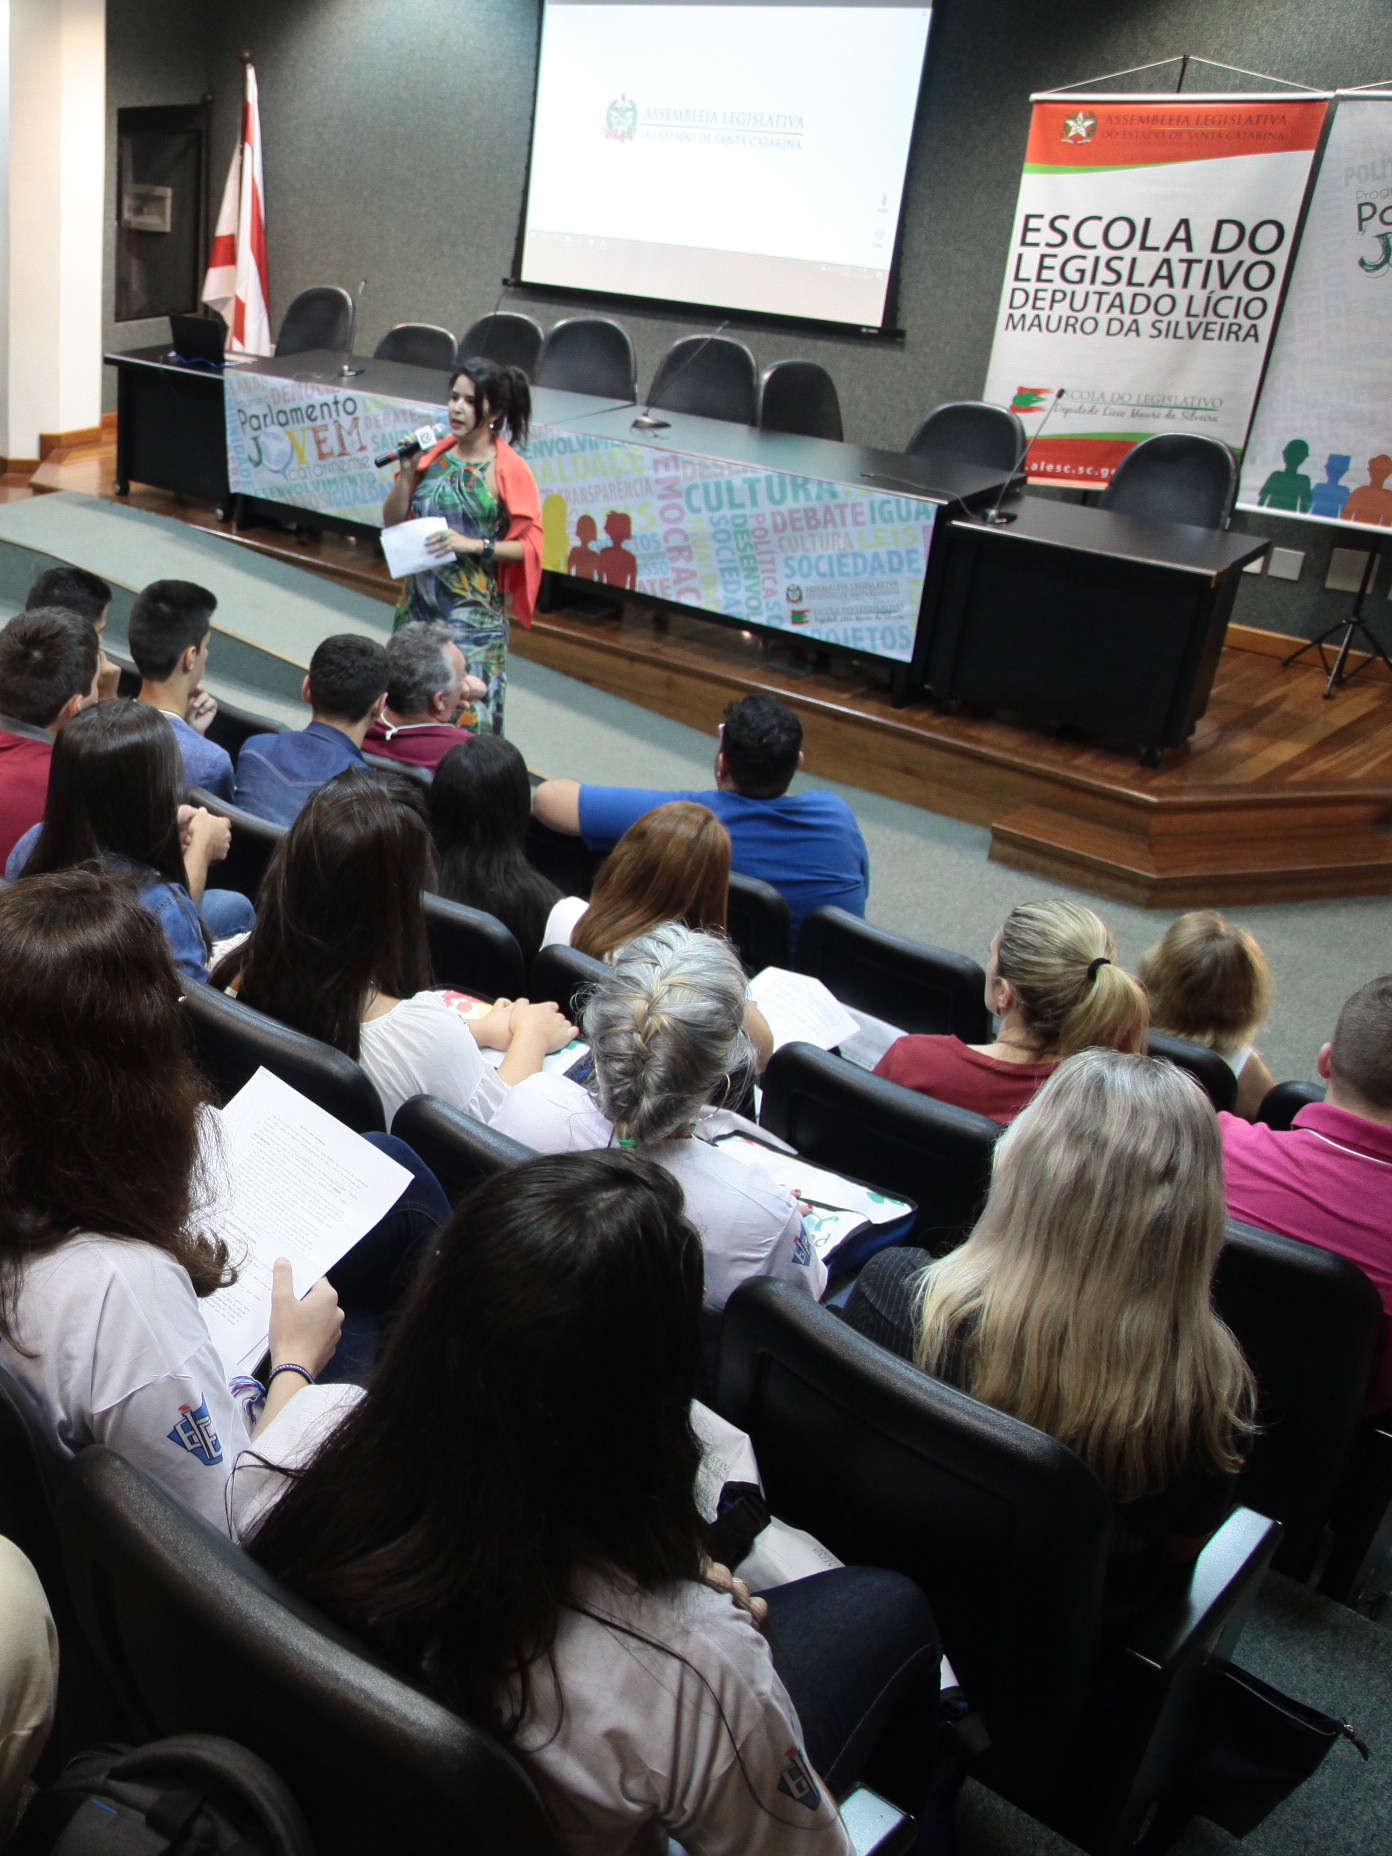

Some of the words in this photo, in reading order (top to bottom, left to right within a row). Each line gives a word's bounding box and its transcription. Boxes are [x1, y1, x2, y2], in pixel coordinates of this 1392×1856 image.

[644, 108, 718, 124] ASSEMBLEIA
[722, 111, 805, 130] LEGISLATIVA
[1105, 113, 1190, 126] ASSEMBLEIA
[1195, 113, 1288, 127] LEGISLATIVA
[749, 136, 803, 150] CATARINA
[1019, 213, 1194, 253] ESCOLA
[1210, 218, 1286, 256] DO
[1013, 252, 1276, 293] LEGISLATIVO
[1008, 288, 1176, 316] DEPUTADO
[1185, 290, 1268, 321] LÍCIO
[1005, 313, 1099, 336] MAURO
[1105, 317, 1141, 338] DA
[1149, 319, 1261, 344] SILVEIRA
[237, 395, 358, 433] Parlamento
[1137, 393, 1224, 409] LEGISLATIVO
[248, 417, 368, 473] JOVEM
[684, 473, 839, 514] CULTURA
[771, 501, 867, 534] DEBATE
[776, 531, 854, 555] CULTURA
[858, 525, 919, 550] LEIS
[783, 548, 923, 580] SOCIEDADE
